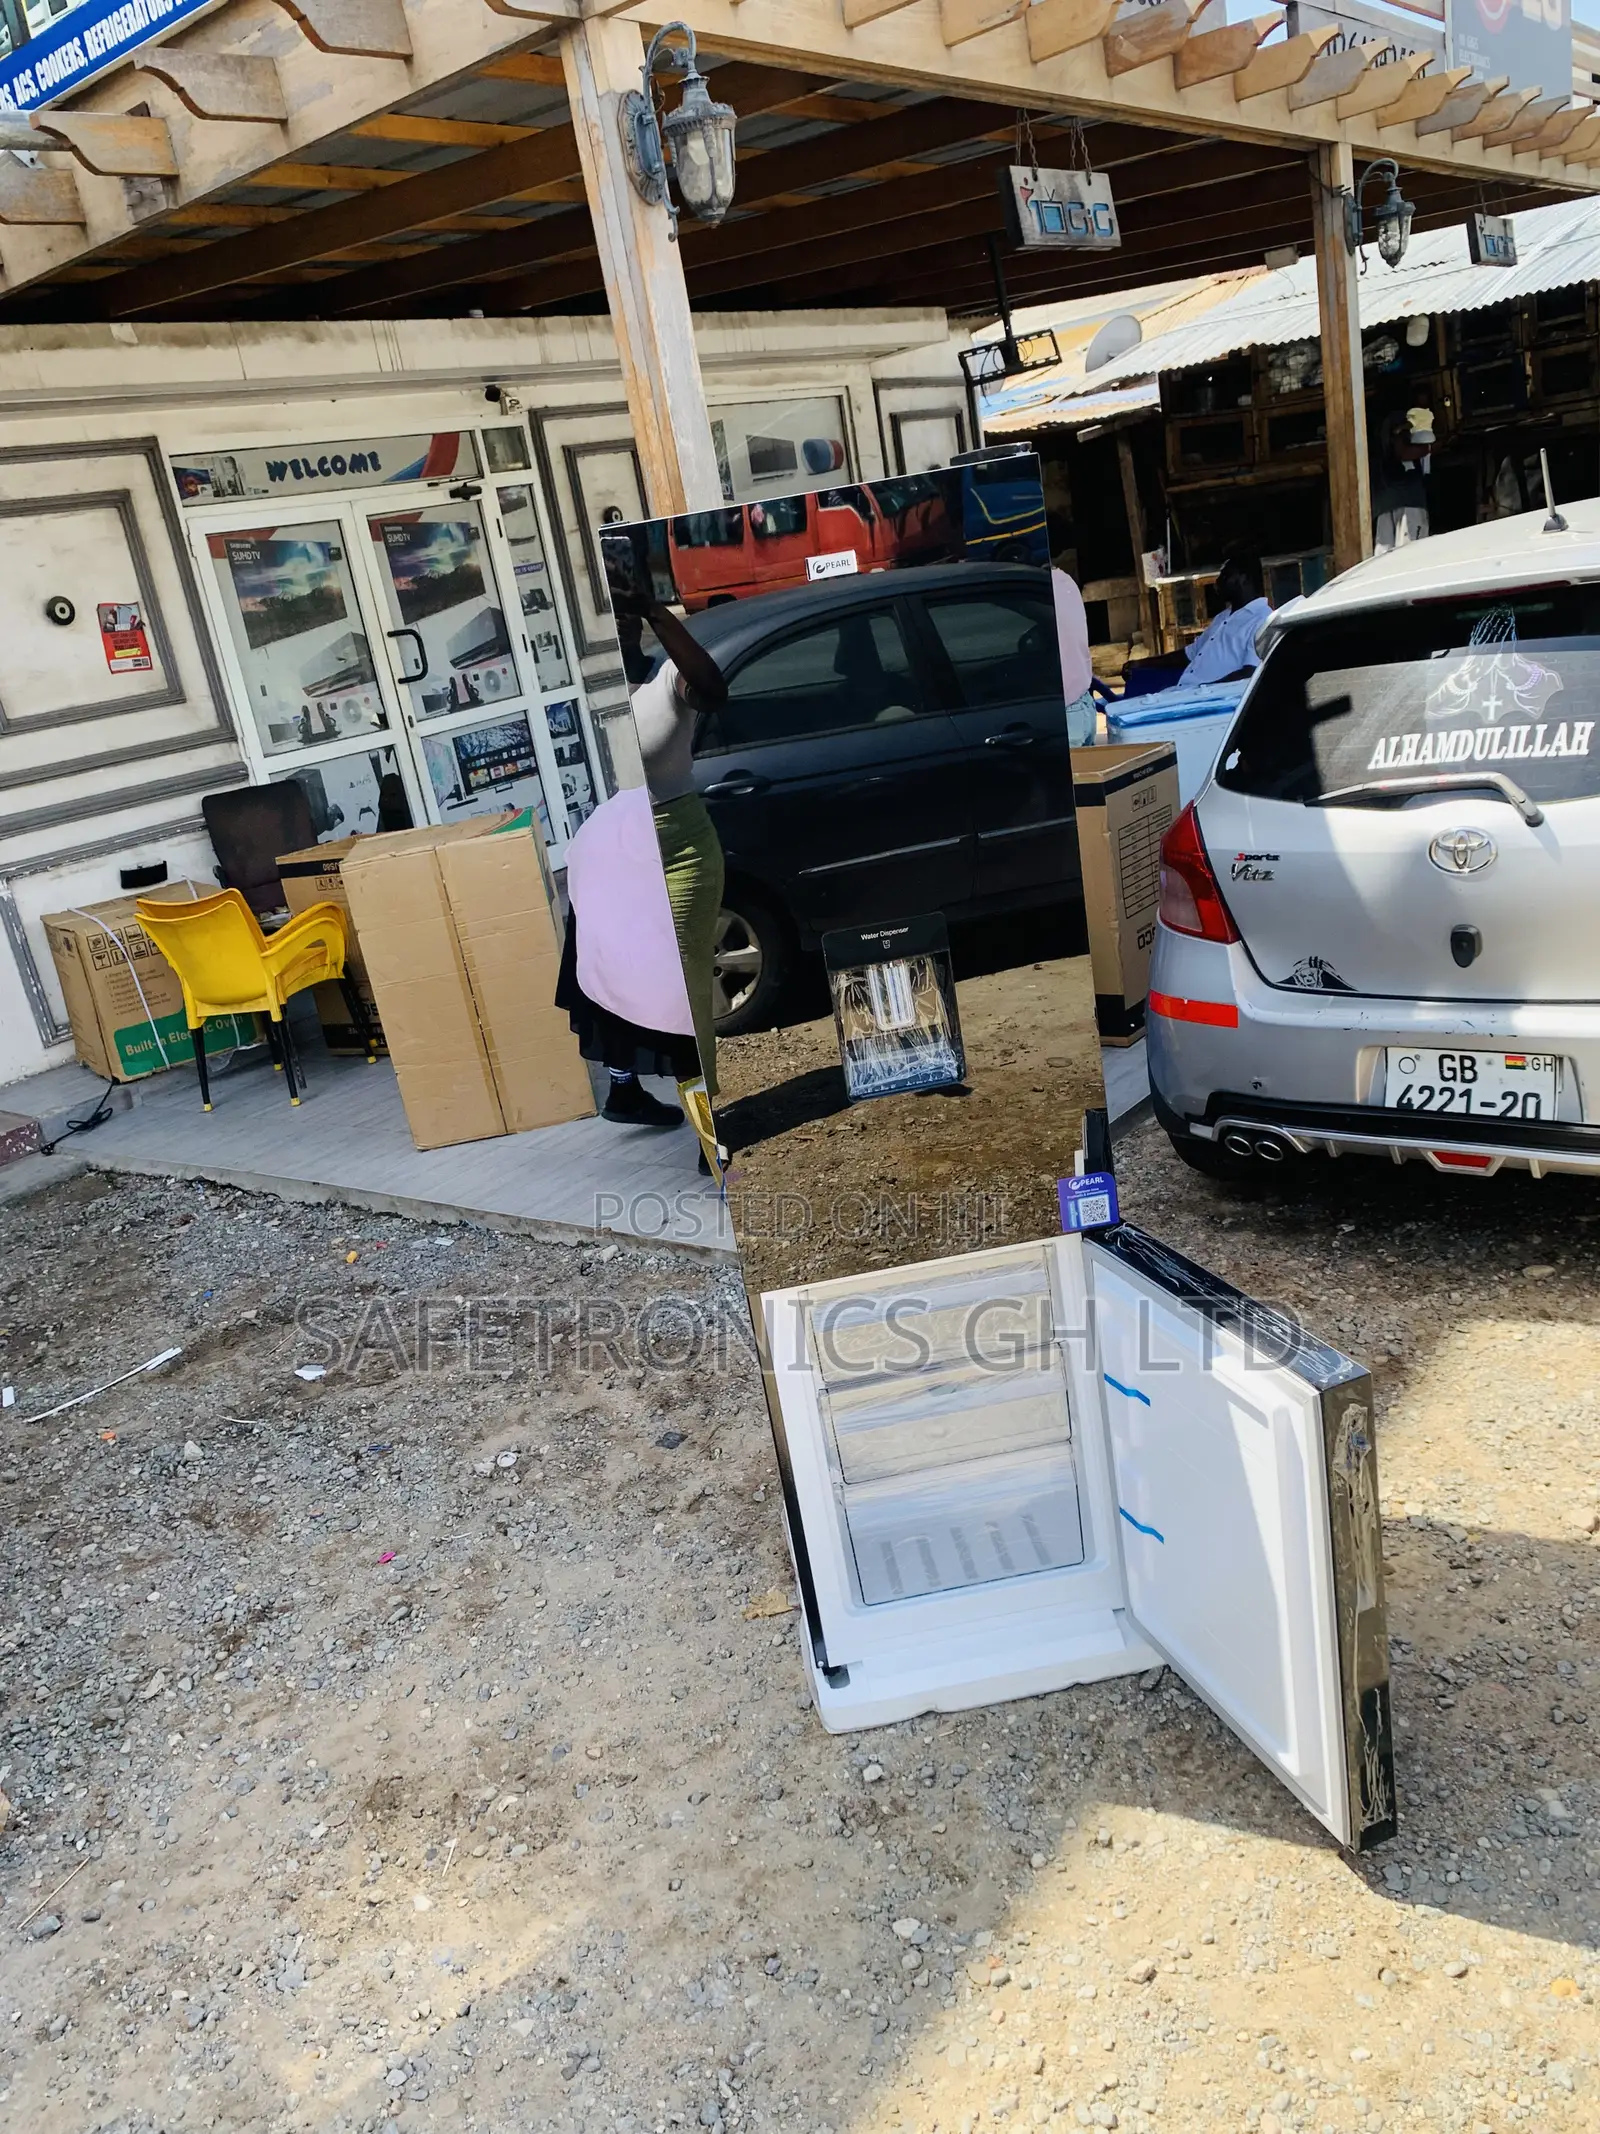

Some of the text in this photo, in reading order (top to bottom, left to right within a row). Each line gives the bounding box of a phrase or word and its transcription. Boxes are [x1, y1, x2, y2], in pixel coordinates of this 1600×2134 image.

[13, 69, 40, 106] ACS,
[35, 36, 89, 91] COOKERS,
[266, 451, 382, 483] WELCOME
[825, 559, 851, 570] PEARL
[1367, 721, 1596, 770] ALHAMDULILLAH
[1230, 864, 1276, 882] Vitz
[880, 927, 909, 937] Dispenser
[169, 1023, 214, 1044] Elecic
[1438, 1054, 1554, 1084] GB GH
[1397, 1084, 1542, 1121] 4221-20
[1080, 1176, 1105, 1187] PEARL
